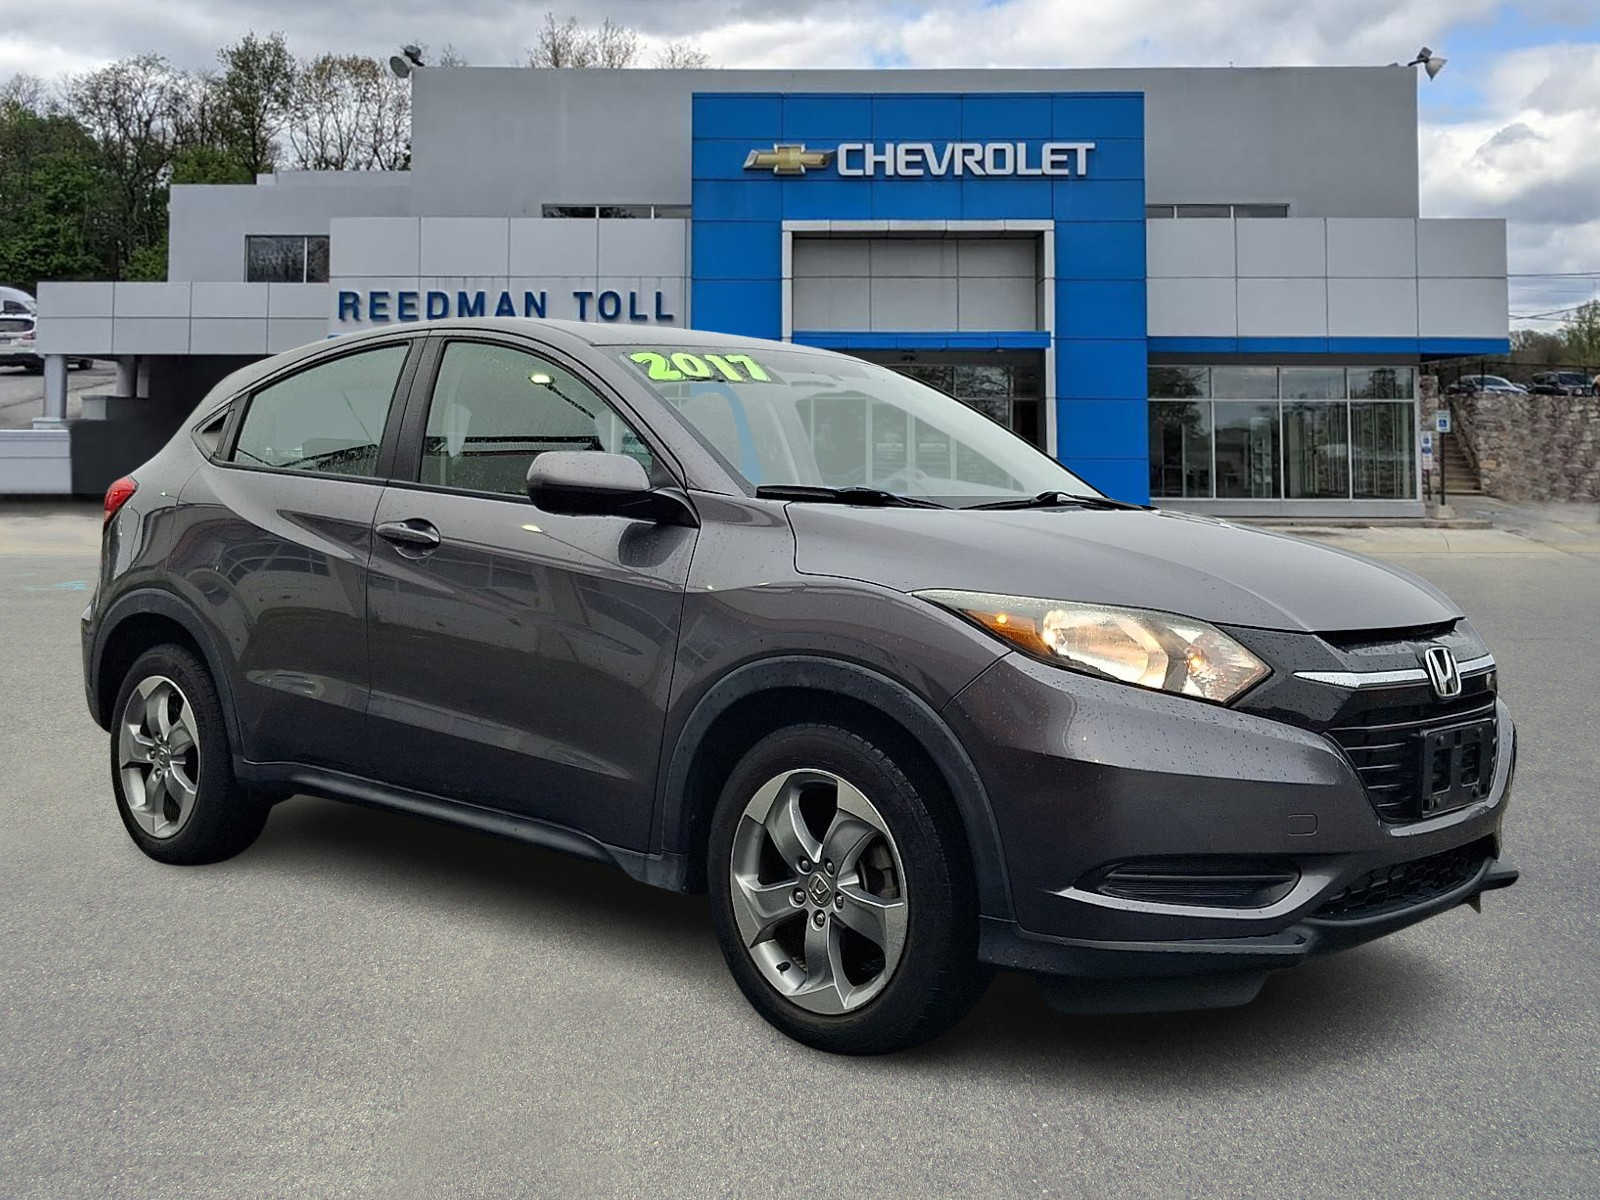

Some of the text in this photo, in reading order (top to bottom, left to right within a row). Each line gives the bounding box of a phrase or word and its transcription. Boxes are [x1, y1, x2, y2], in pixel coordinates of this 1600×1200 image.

[837, 143, 1096, 177] CHEVROLET
[338, 291, 675, 322] REEDMAN TOLL
[629, 351, 772, 382] 2017
